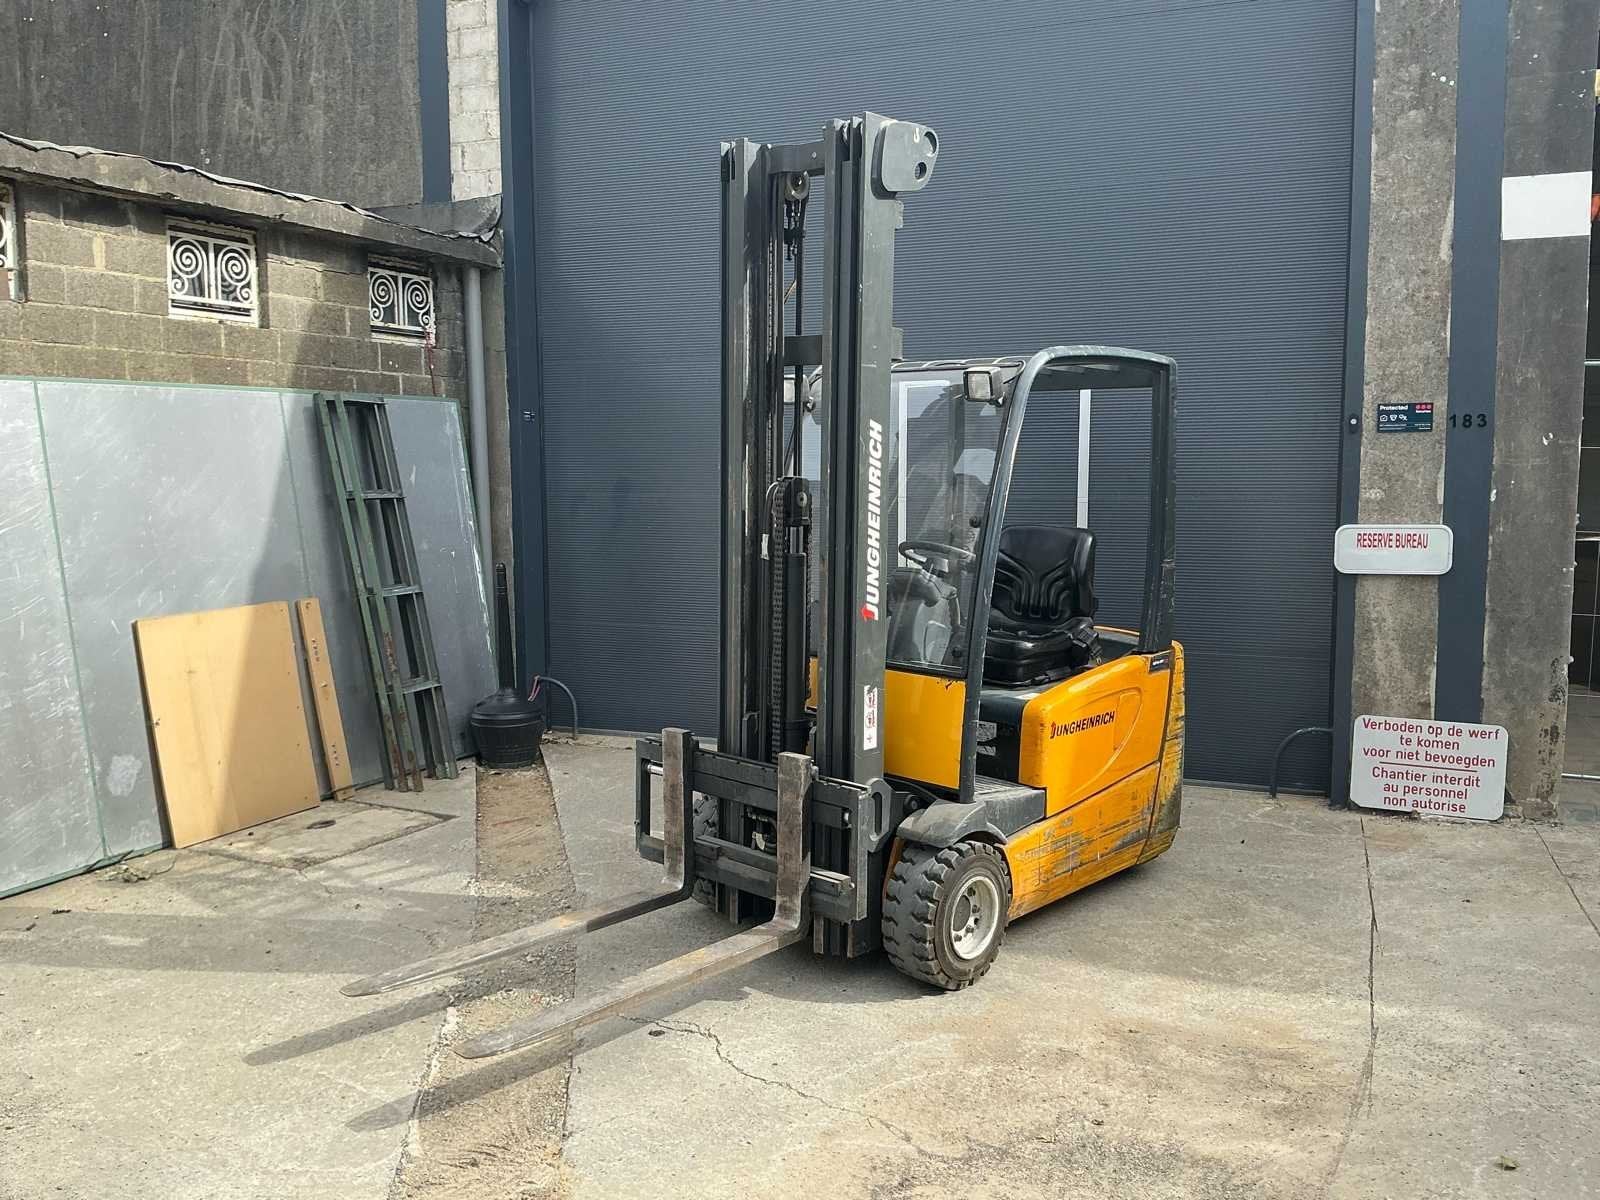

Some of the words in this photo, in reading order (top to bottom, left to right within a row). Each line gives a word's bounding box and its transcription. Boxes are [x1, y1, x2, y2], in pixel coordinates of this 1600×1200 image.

[1449, 413, 1487, 428] 183
[860, 418, 883, 621] JUNGHEINRICH
[1356, 533, 1393, 548] RESERVE
[1395, 533, 1429, 549] BUREAU
[1050, 711, 1115, 739] JUNGHEINRICH
[1363, 717, 1423, 733] Verboden
[1428, 725, 1443, 737] op
[1447, 725, 1463, 737] de
[1468, 728, 1500, 740] werf
[1400, 735, 1412, 746] te
[1417, 736, 1460, 750] komen
[1363, 747, 1391, 758] voor
[1396, 749, 1420, 761] niet
[1425, 751, 1496, 769] bevoegden
[1372, 766, 1427, 783] Chantier
[1432, 771, 1481, 788] interdit
[1383, 783, 1399, 793] au
[1403, 784, 1468, 800] personnel
[1383, 796, 1407, 807] non
[1411, 798, 1466, 813] autorise
